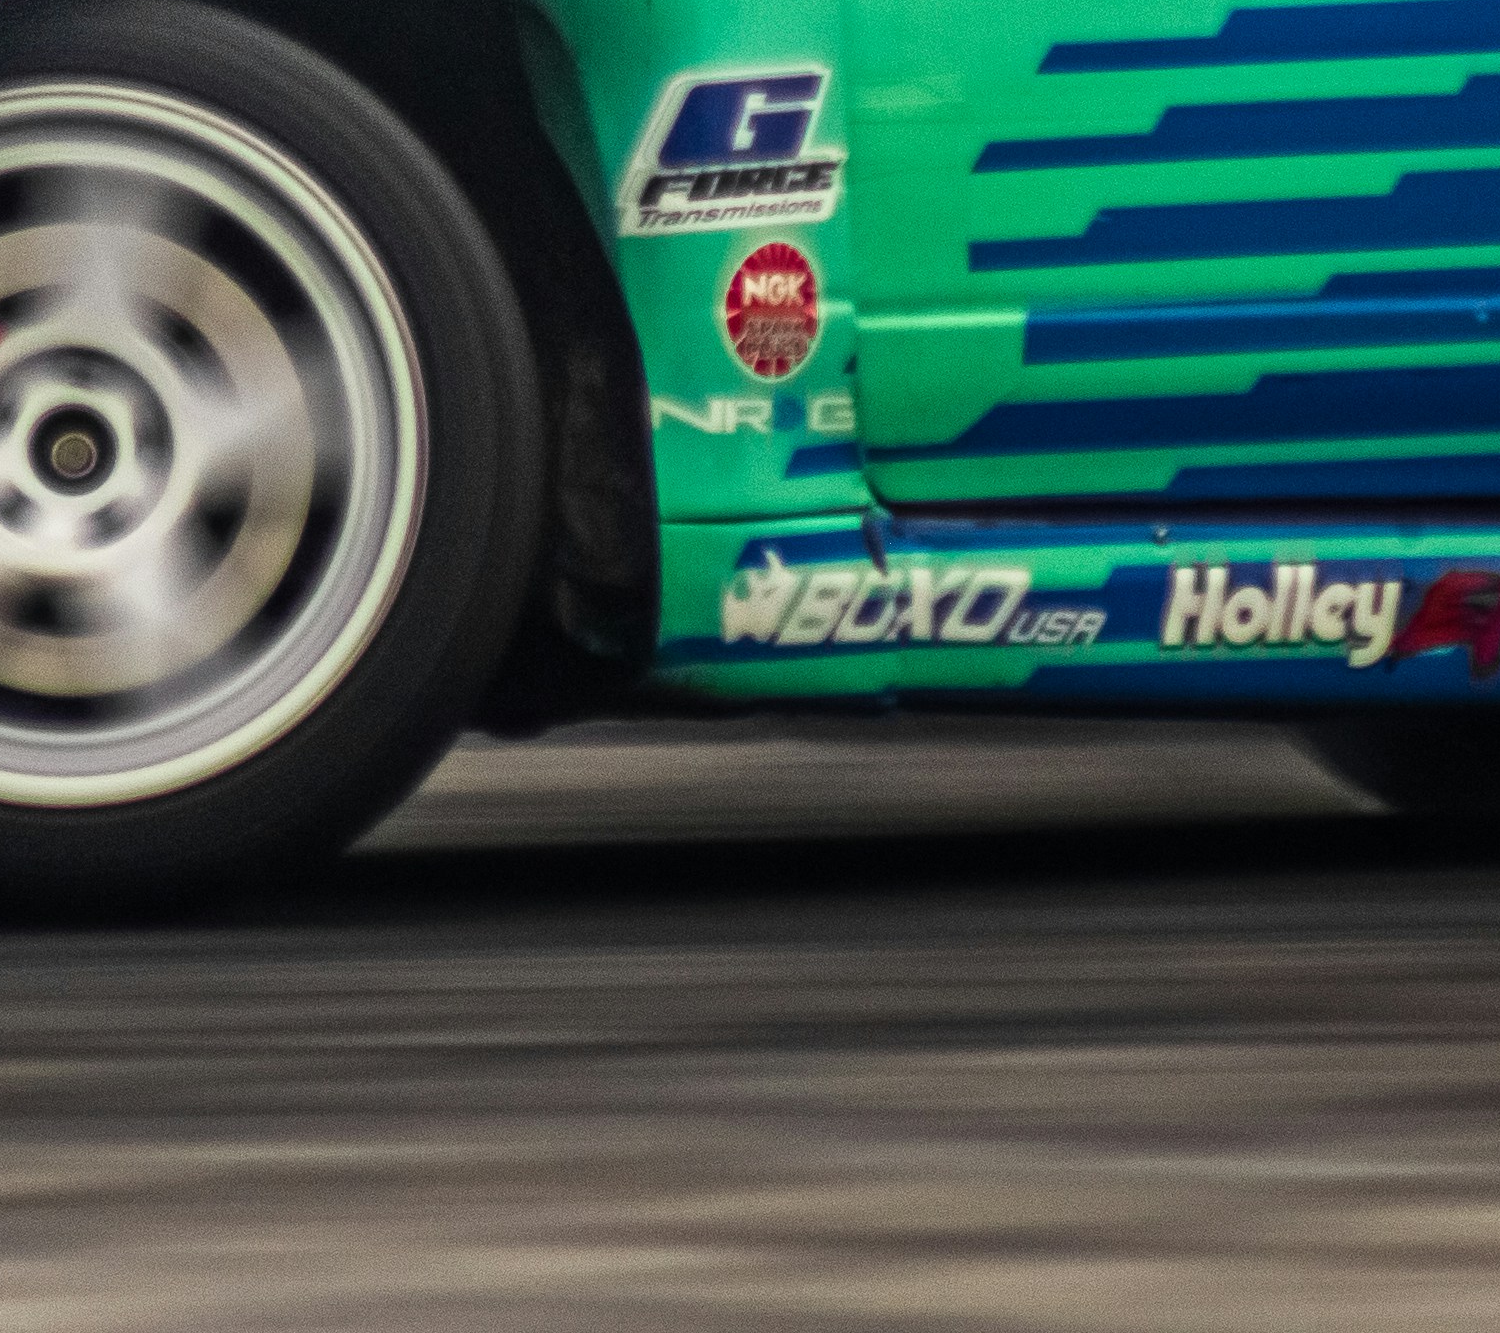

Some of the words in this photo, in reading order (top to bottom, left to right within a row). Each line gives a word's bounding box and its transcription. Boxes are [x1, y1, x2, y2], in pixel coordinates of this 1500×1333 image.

[639, 161, 842, 210] FORCE
[637, 199, 826, 227] Transmissions
[742, 273, 810, 307] NGK
[774, 567, 1033, 646] BOXO
[1009, 609, 1108, 645] USA
[1160, 563, 1403, 668] Holley
